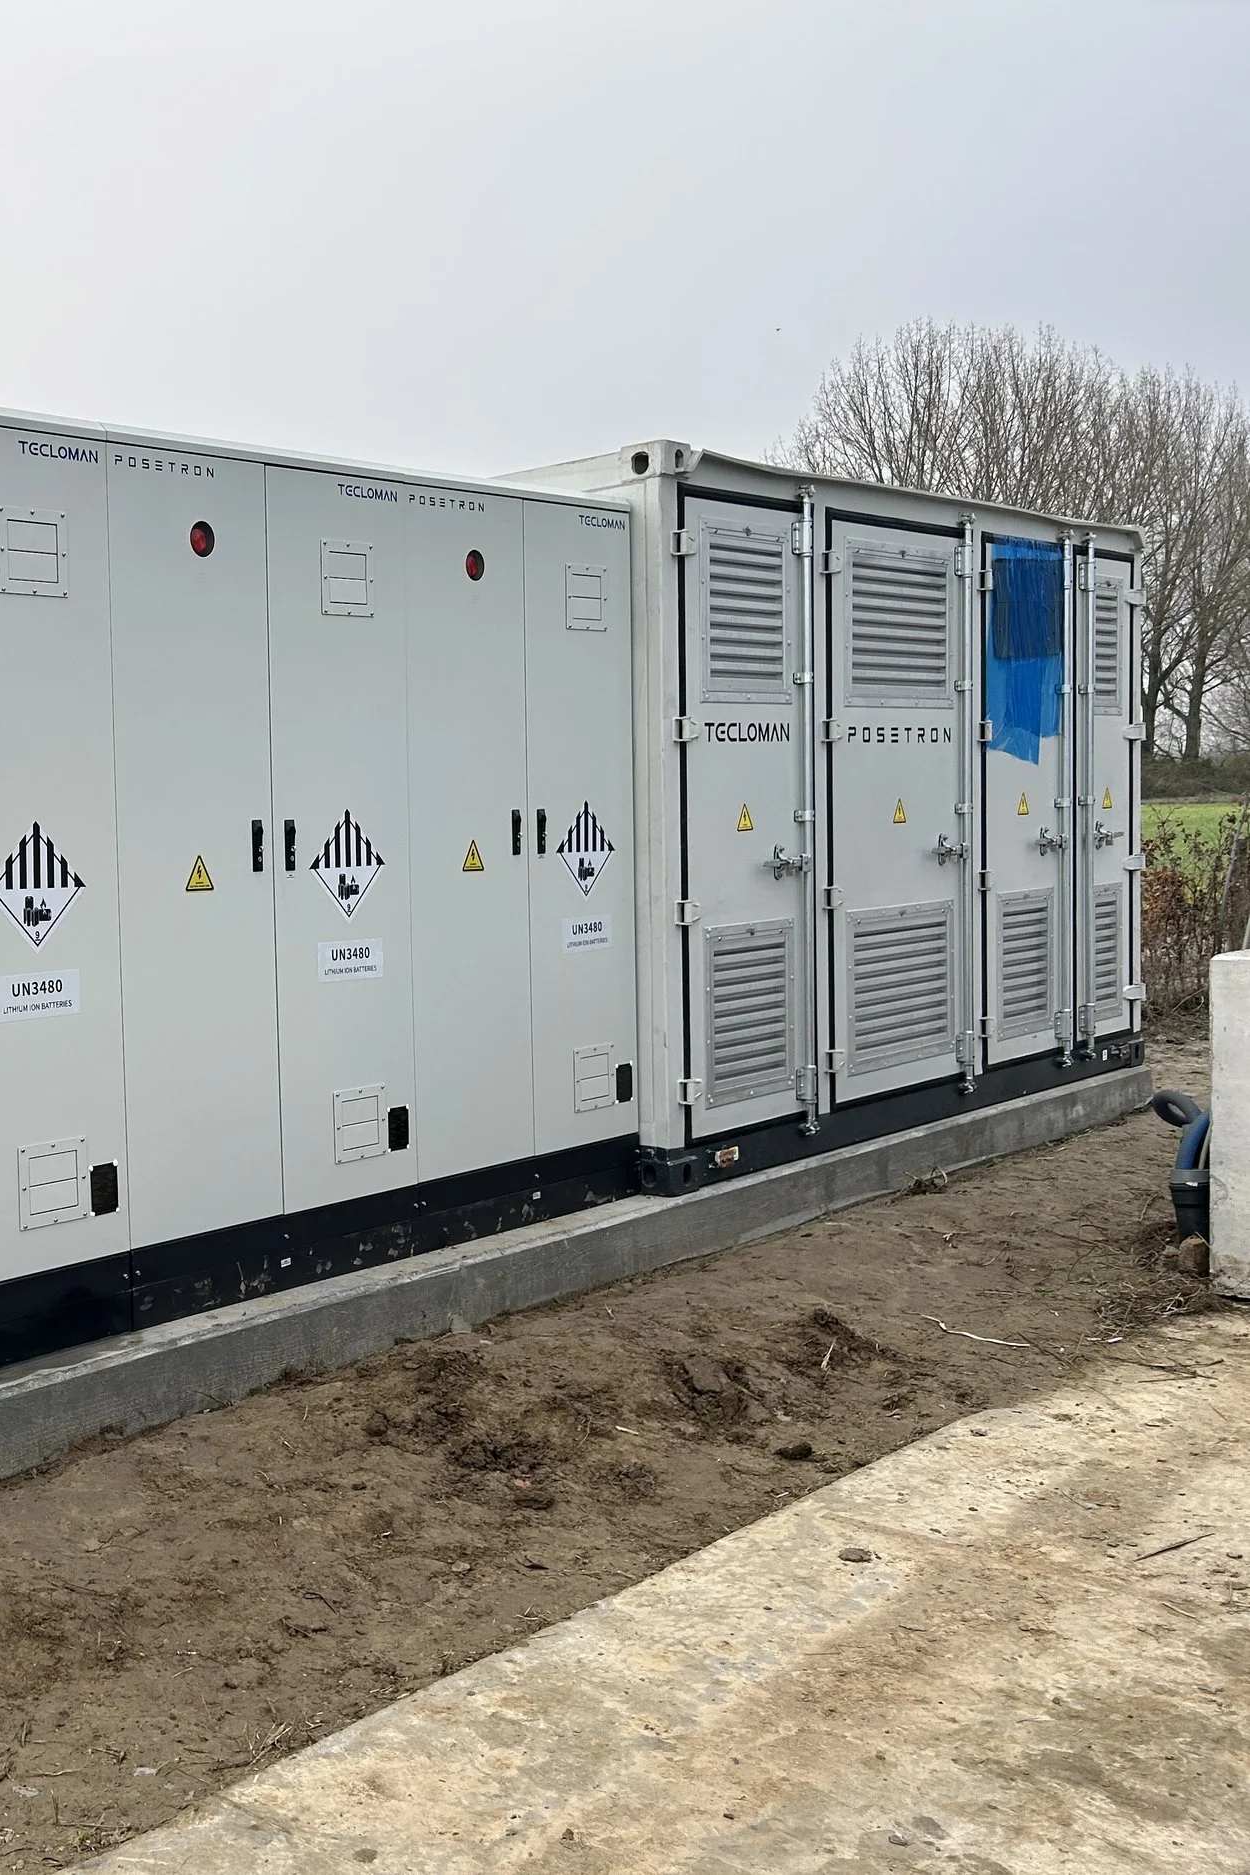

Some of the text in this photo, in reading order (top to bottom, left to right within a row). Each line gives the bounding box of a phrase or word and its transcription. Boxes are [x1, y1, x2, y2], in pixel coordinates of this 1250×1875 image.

[18, 440, 99, 463] TECLOMAN
[114, 455, 214, 478] POSETRON
[337, 484, 398, 503] TECLOMAN
[409, 495, 485, 512] POSETRON
[578, 514, 626, 530] TECLOMAN
[705, 722, 790, 742] TECLOMAN
[848, 727, 951, 743] POSETRON
[35, 930, 40, 939] 9
[572, 921, 602, 936] UN3480
[332, 946, 370, 962] UN3480
[324, 964, 377, 976] LITHIUM ION BATTERIES
[12, 979, 63, 997] UN3480
[3, 1000, 73, 1015] LITHIUM ION BATTERIES
